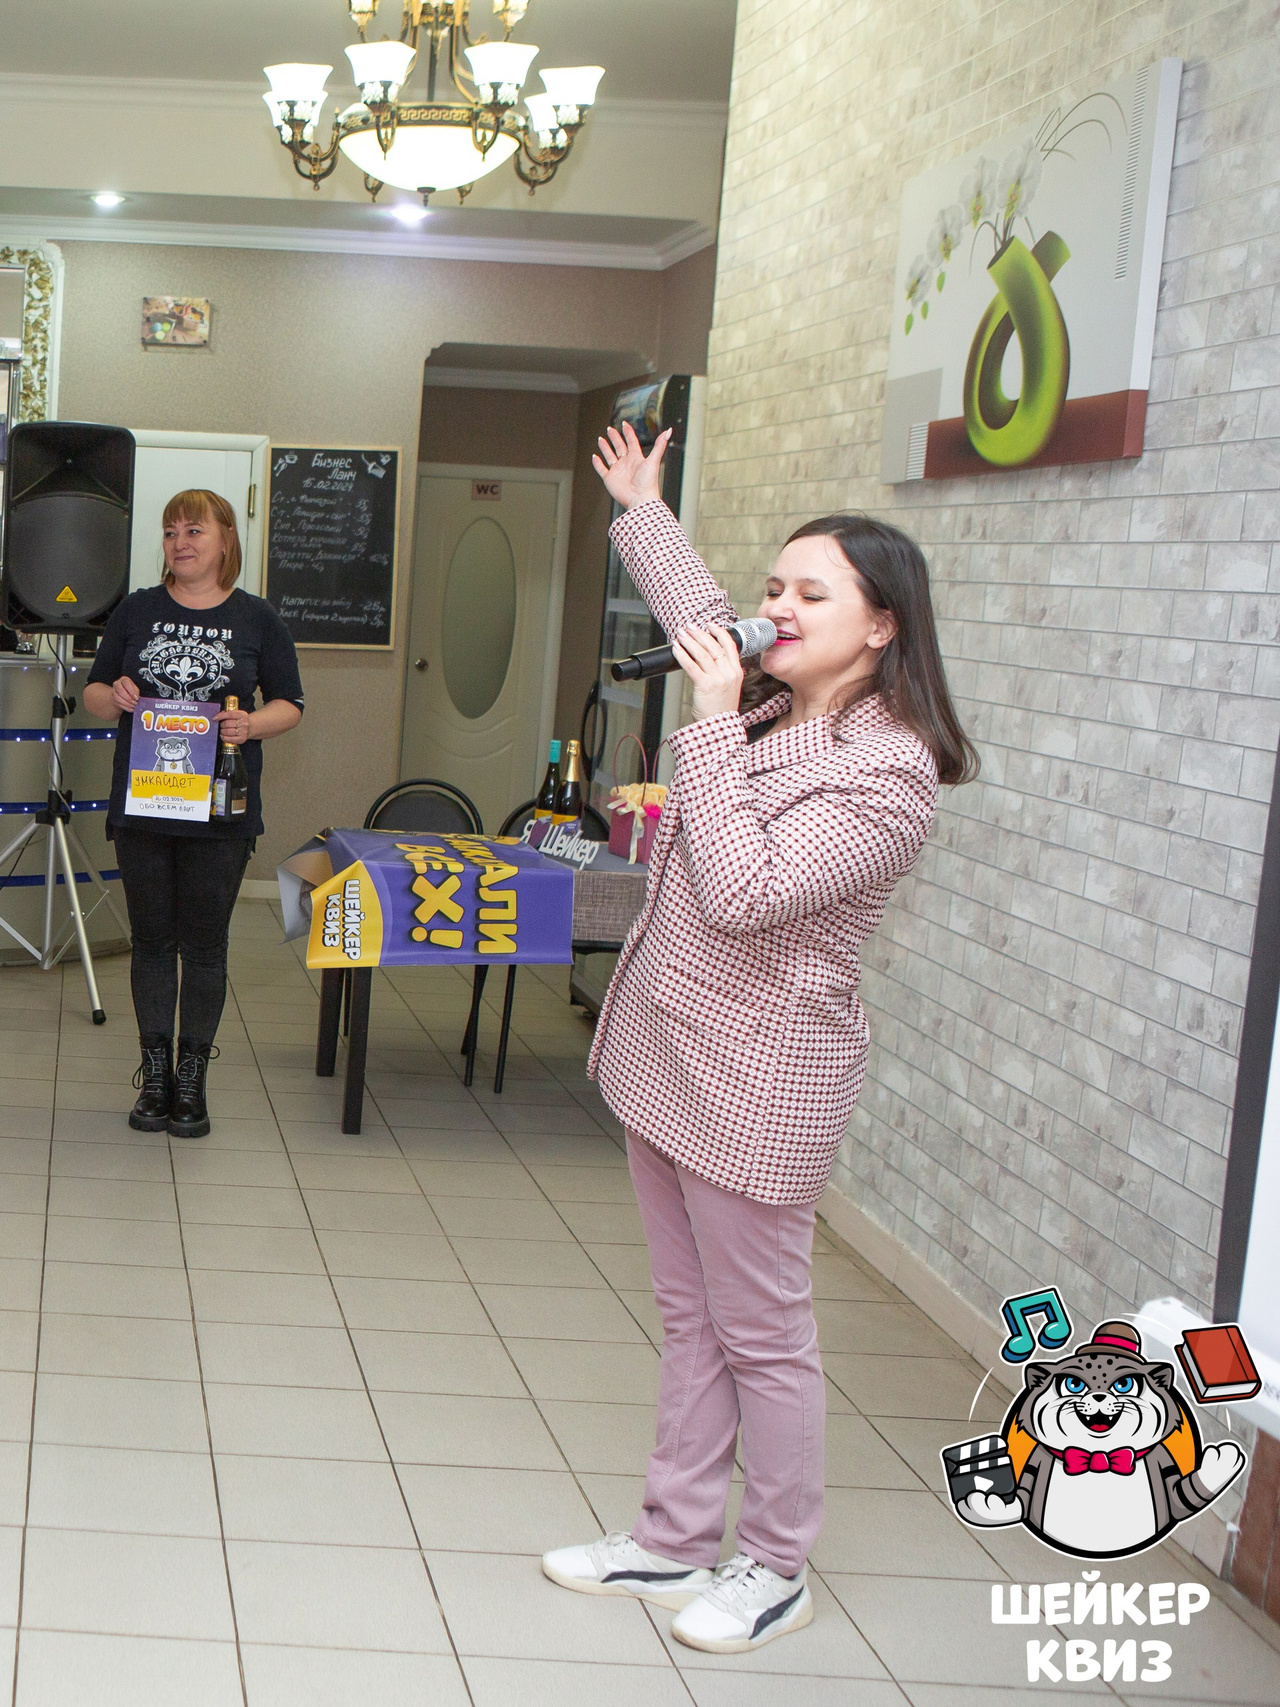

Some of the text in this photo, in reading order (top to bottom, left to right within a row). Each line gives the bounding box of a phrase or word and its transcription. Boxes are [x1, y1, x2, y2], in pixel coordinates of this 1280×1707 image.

[311, 452, 353, 469] Бизнес
[327, 468, 357, 481] Ланч
[302, 477, 354, 492] 16.02.2024
[476, 483, 500, 495] WC
[281, 595, 320, 606] Напиток
[152, 621, 233, 641] LONDON
[154, 702, 199, 712] ШЕЙКЕР КВИЗ
[141, 710, 210, 735] 1 МЕСТО
[520, 819, 538, 845] Я
[323, 892, 342, 948] КВИЗ
[342, 879, 366, 961] ШЕЙКЕР
